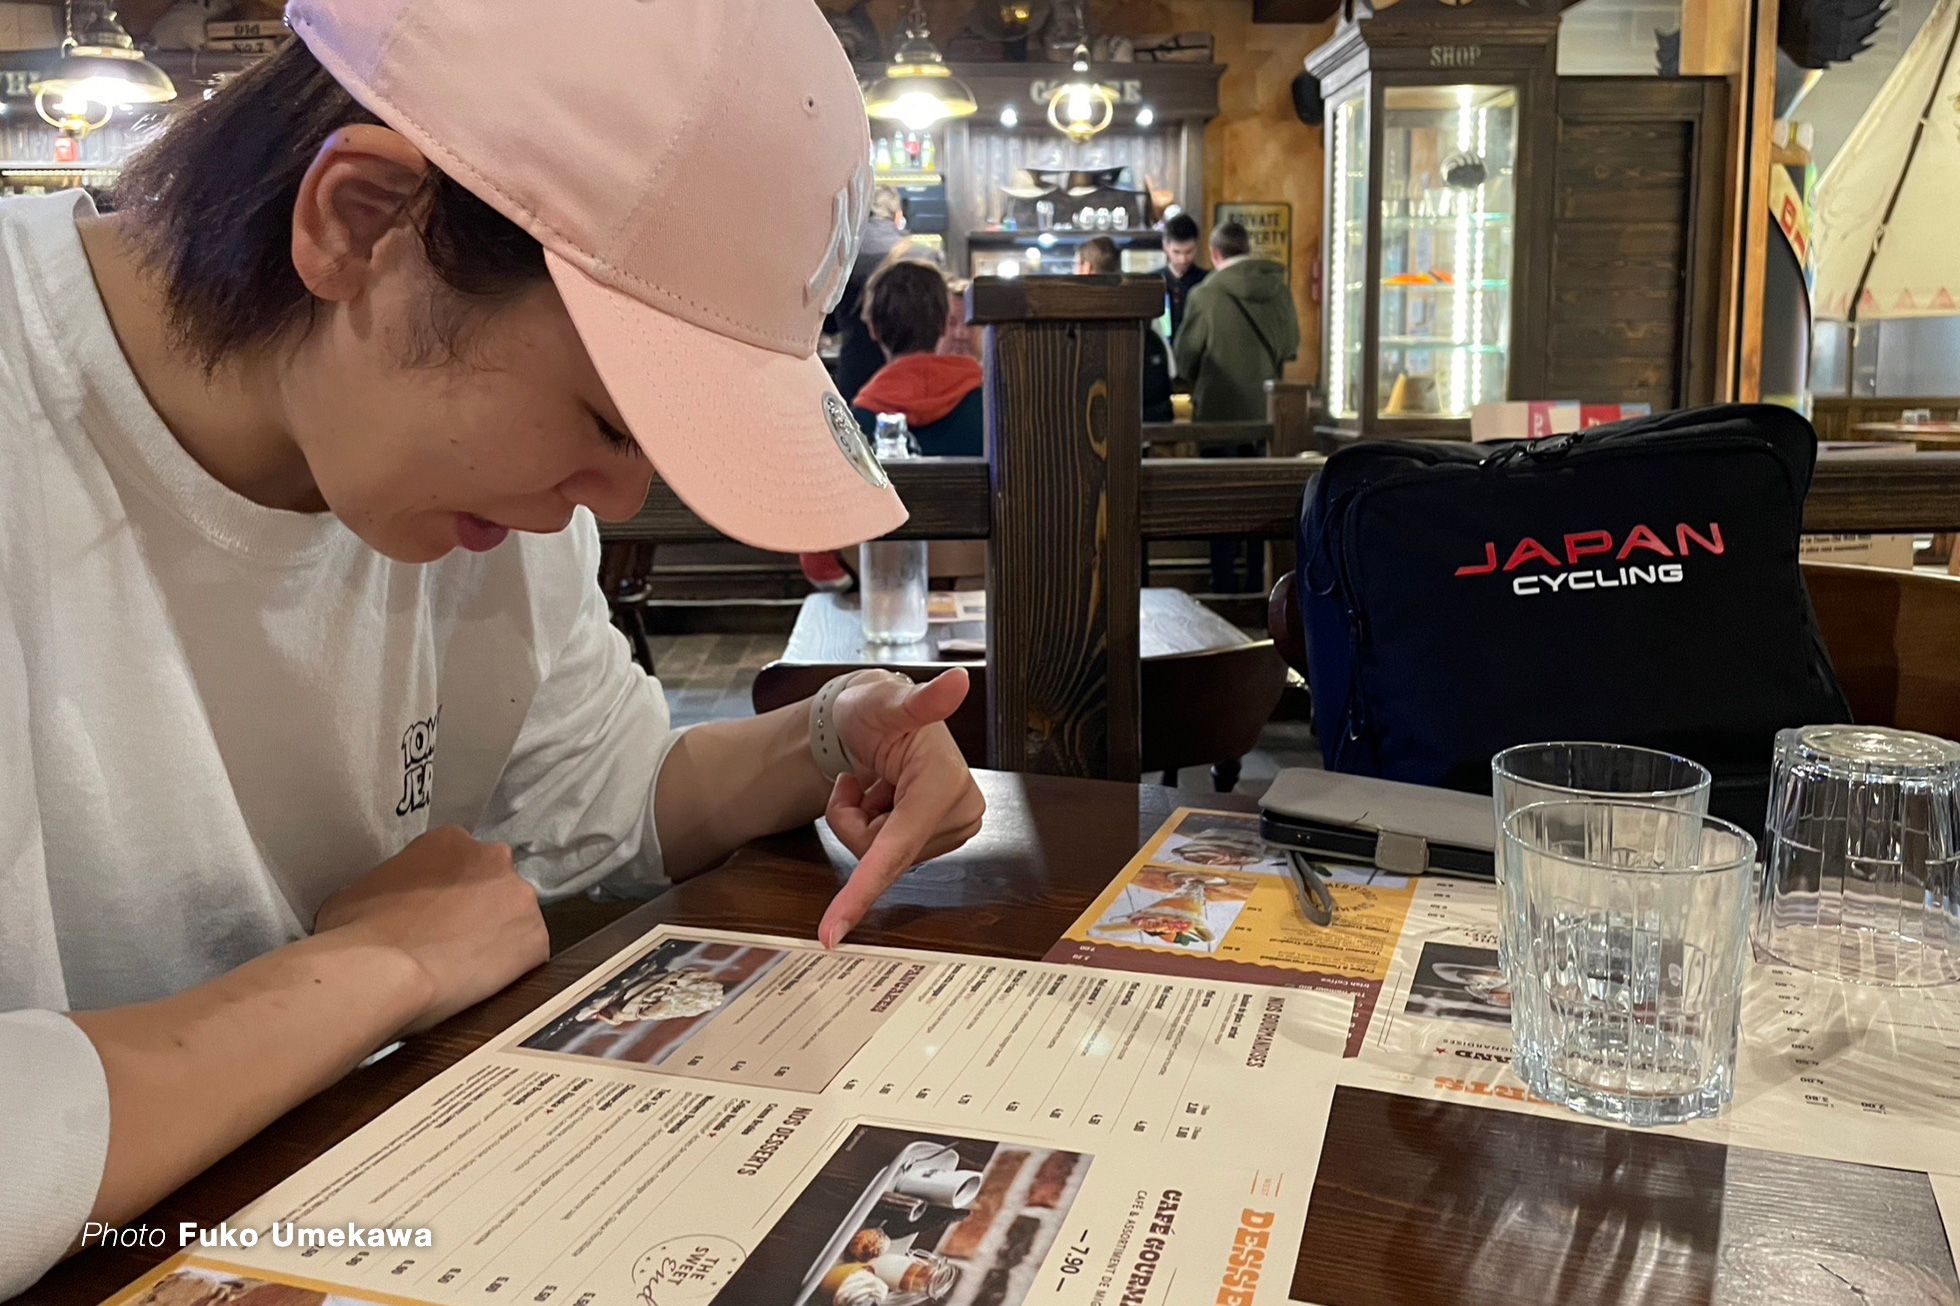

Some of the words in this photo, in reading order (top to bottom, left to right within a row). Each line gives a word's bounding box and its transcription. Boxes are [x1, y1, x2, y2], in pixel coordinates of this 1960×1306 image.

[1430, 46, 1481, 67] SHOP
[1454, 522, 1724, 576] JAPAN
[1512, 563, 1683, 596] CYCLING
[870, 964, 925, 1012] PANCAKES
[1246, 1014, 1280, 1067] GOURMANDISES
[783, 1107, 812, 1126] NOS
[737, 1127, 794, 1175] DESSERTS
[1132, 1190, 1147, 1209] CAFÉ
[1150, 1190, 1182, 1235] CAFÉ
[1060, 1246, 1090, 1274] 7.90
[1106, 1219, 1136, 1274] ASSORTIMENT
[1216, 1208, 1274, 1306] DESSE
[637, 1257, 677, 1306] End
[668, 1247, 709, 1286] SWEET
[690, 1258, 720, 1280] THE
[1099, 1276, 1112, 1287] DE
[534, 1286, 557, 1301] 5.50
